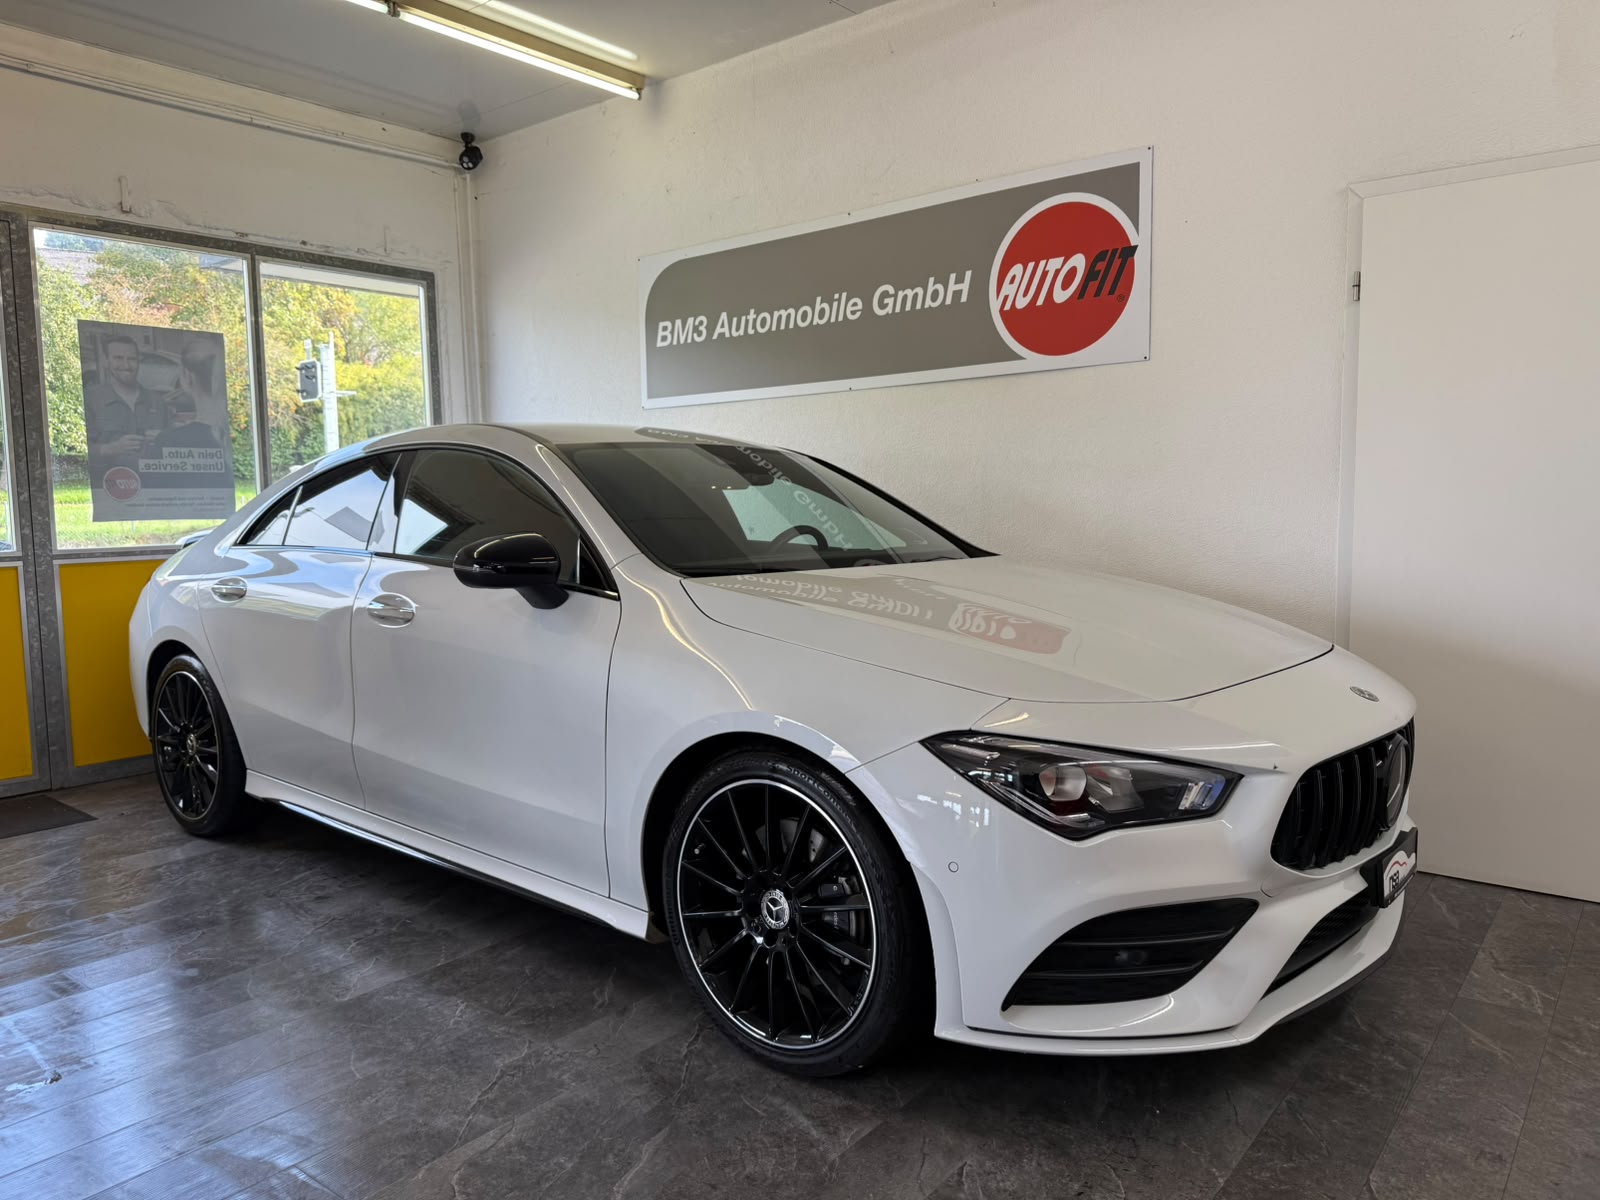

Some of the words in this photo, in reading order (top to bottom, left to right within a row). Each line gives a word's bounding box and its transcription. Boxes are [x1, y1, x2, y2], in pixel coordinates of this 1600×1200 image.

[656, 316, 707, 347] BM3
[711, 292, 862, 340] Automobile
[872, 270, 972, 316] GmbH
[997, 245, 1138, 311] AUTOFIT
